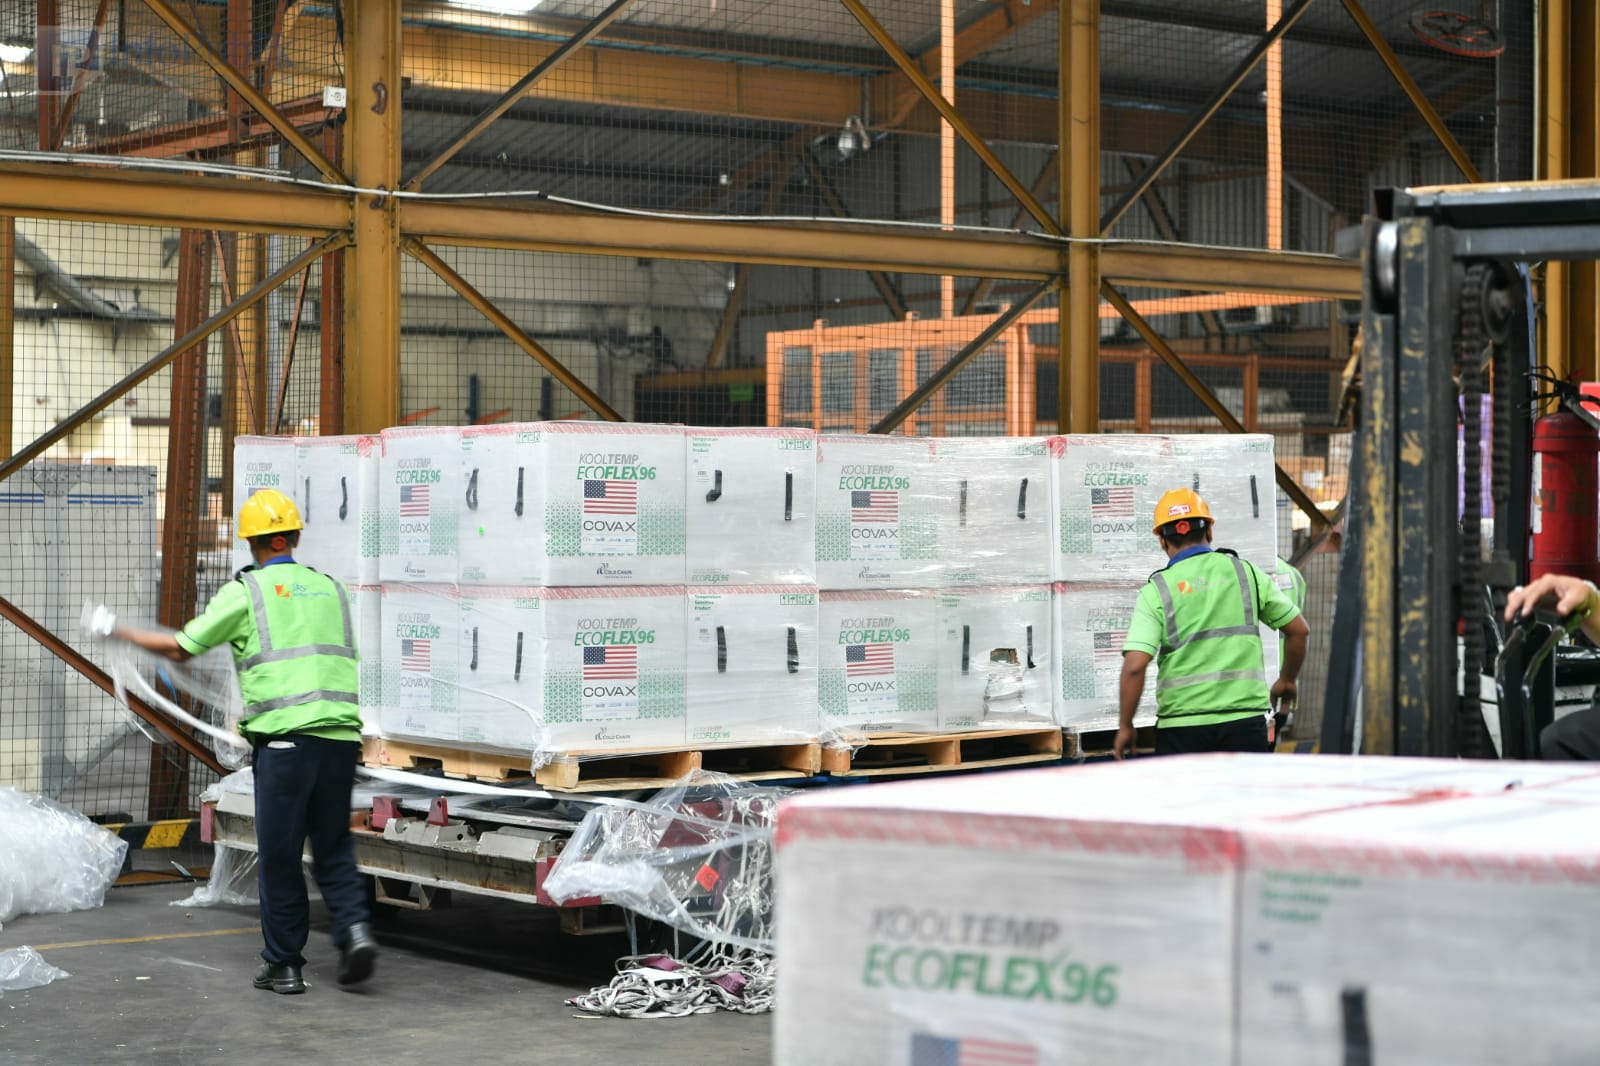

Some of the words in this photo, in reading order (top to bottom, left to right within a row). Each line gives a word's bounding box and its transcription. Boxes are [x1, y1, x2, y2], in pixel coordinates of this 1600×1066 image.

[578, 454, 639, 465] KOOLTEMP
[841, 464, 894, 475] KOOLTEMP
[399, 523, 430, 533] COVAX
[583, 520, 636, 532] COVAX
[1092, 523, 1136, 533] COVAX
[851, 529, 898, 539] COVAX
[576, 618, 638, 630] KOOLTEMP
[840, 618, 895, 629] KOOLTEMP
[583, 686, 636, 698] COVAX
[848, 680, 896, 693] COVAX
[868, 906, 1061, 947] KOOLTEMP
